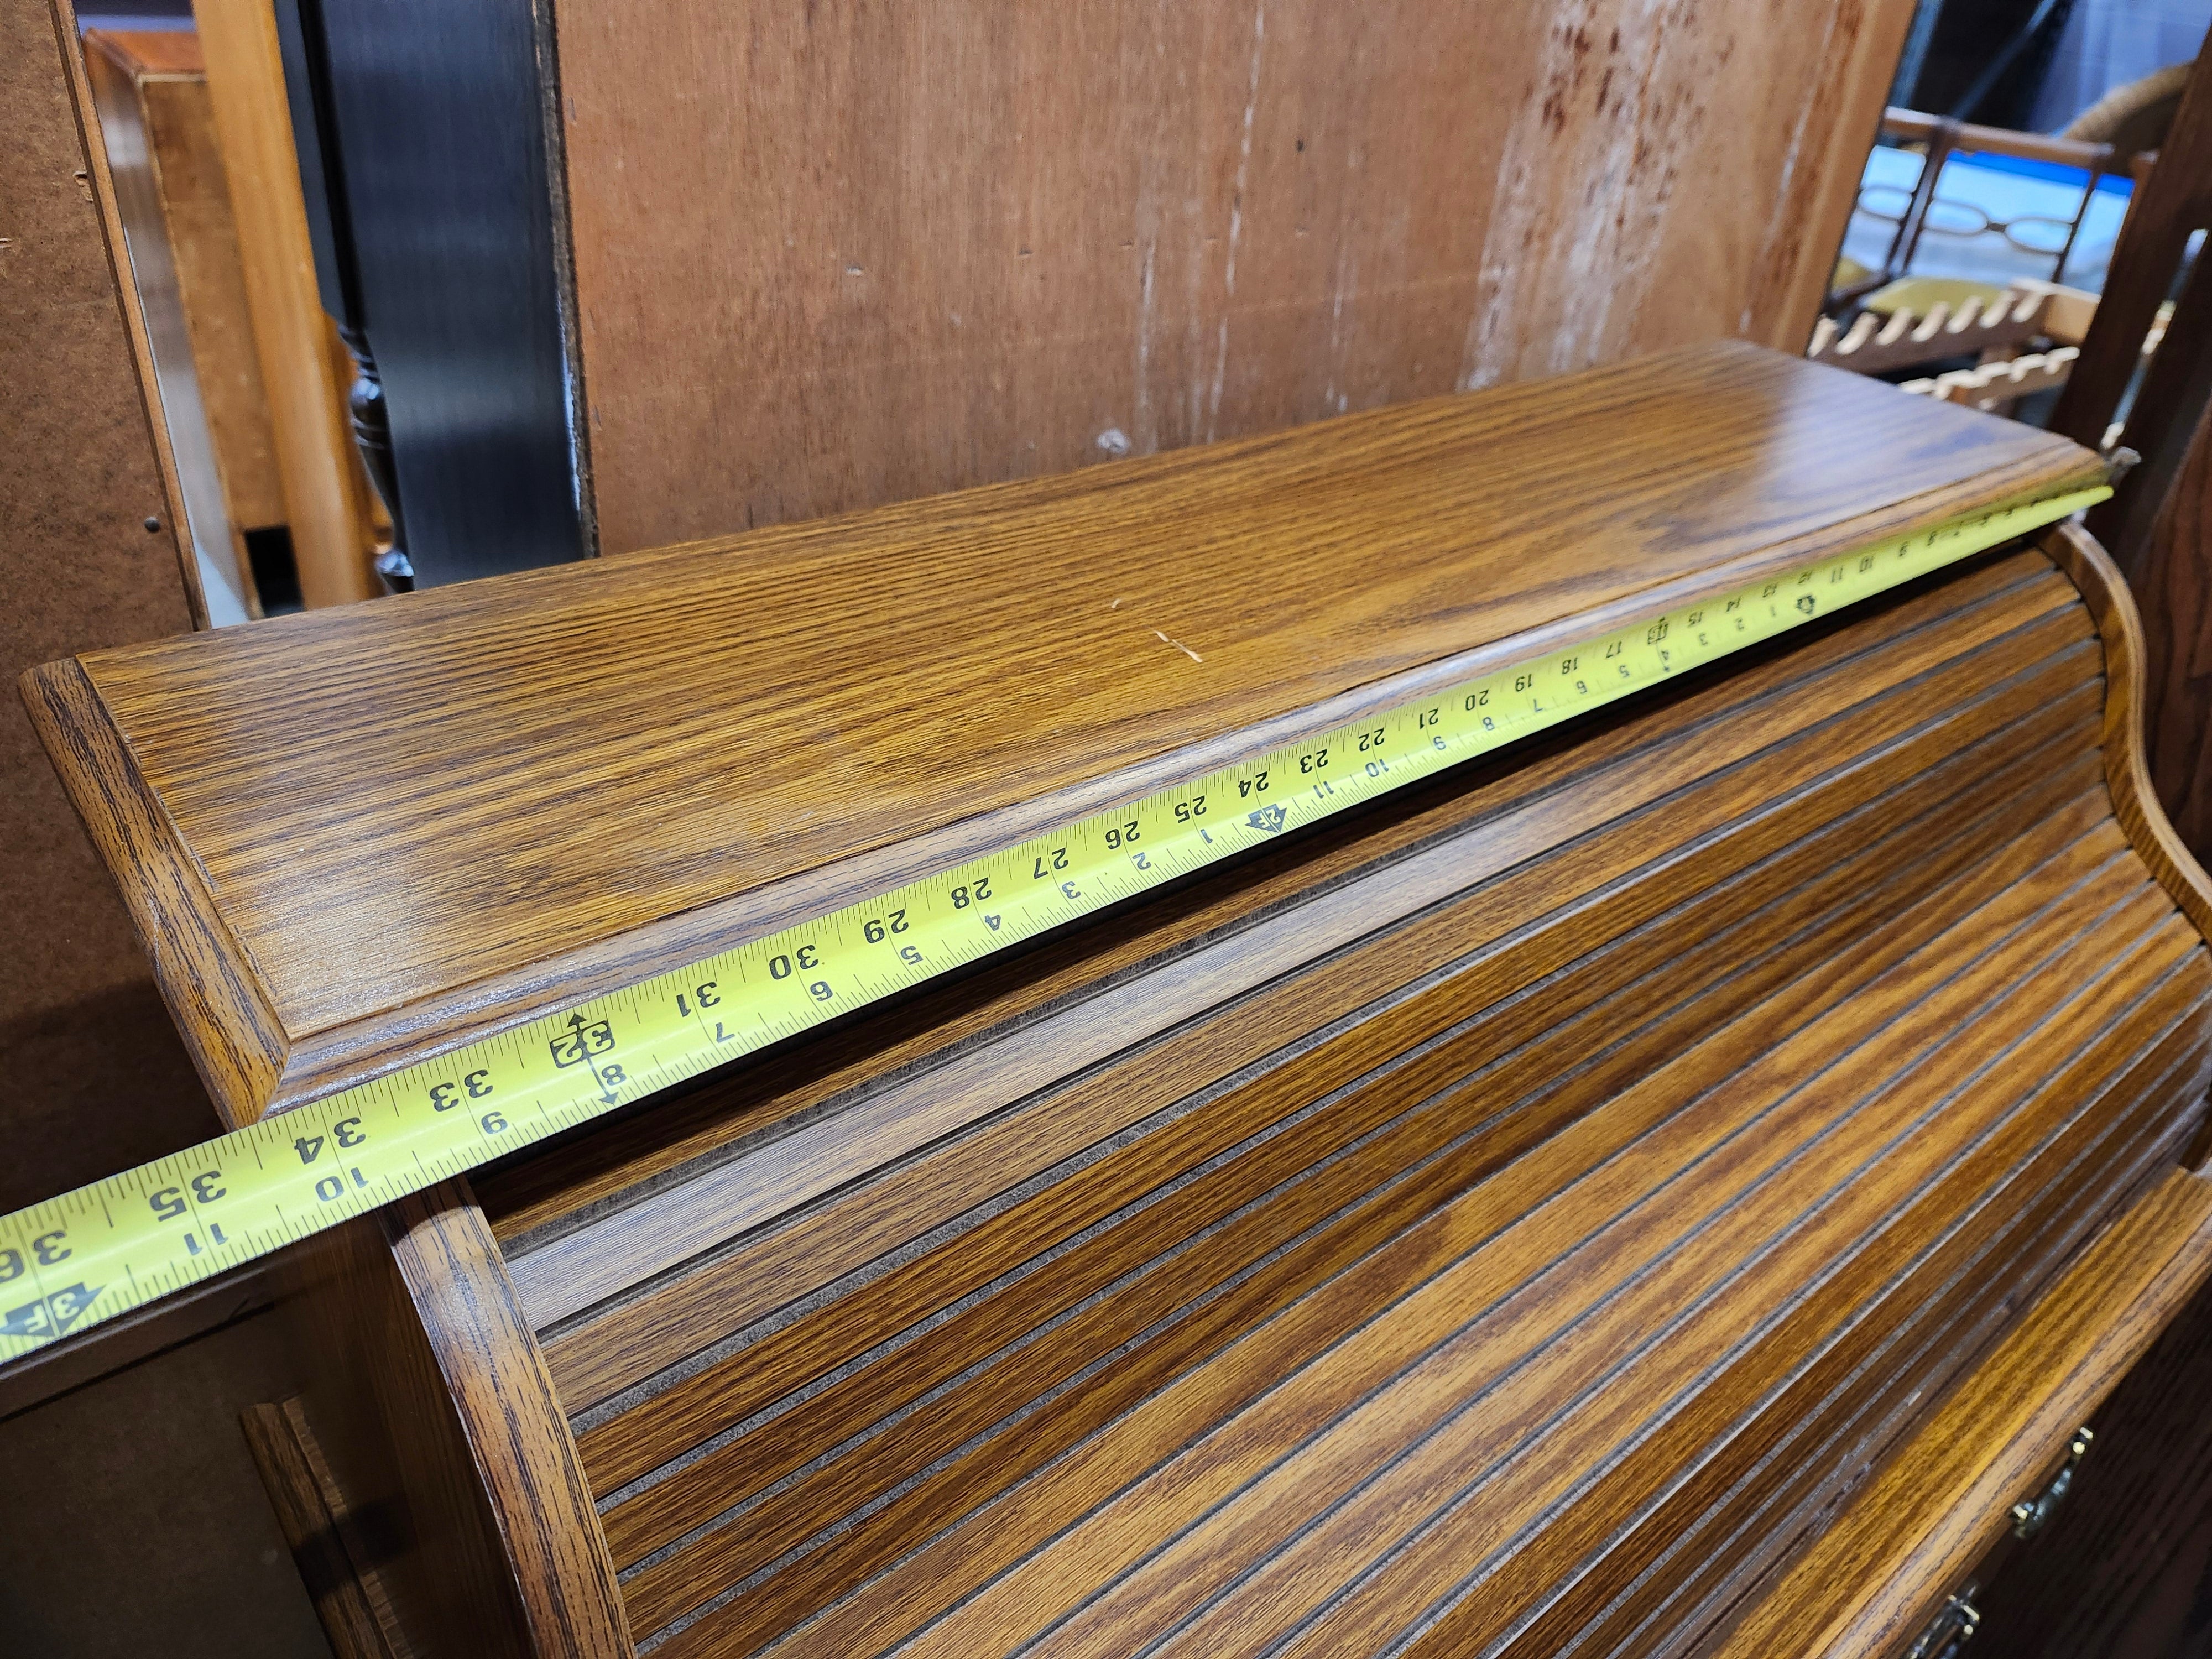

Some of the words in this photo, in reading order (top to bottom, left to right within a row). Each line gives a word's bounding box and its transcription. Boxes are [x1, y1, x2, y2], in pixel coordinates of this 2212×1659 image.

[1859, 555, 1874, 572] 10
[1831, 566, 1843, 583] 11
[1726, 596, 1742, 612] 14
[1688, 611, 1704, 627] 15
[1699, 632, 1708, 645] 3
[1606, 641, 1622, 659] 17
[1562, 658, 1578, 675] 18
[1619, 665, 1630, 677] 5
[1515, 674, 1532, 692] 19
[1577, 681, 1588, 694] 6
[1465, 690, 1489, 711] 20
[1533, 699, 1543, 712] 7
[1420, 708, 1438, 729] 21
[1483, 717, 1495, 731] 8
[1359, 728, 1385, 751] 22
[1433, 736, 1446, 750] 9
[1300, 749, 1328, 774] 23
[1365, 759, 1390, 777] 10
[1238, 771, 1269, 797] 24
[1313, 781, 1334, 799] 11
[1175, 796, 1207, 823] 25
[1257, 807, 1281, 830] 2F
[1105, 821, 1140, 849] 26
[1201, 829, 1213, 843] 1
[1034, 848, 1068, 879] 27
[1132, 852, 1151, 870] 2
[951, 877, 992, 909] 28
[1062, 881, 1081, 899] 3
[864, 909, 909, 943] 29
[984, 915, 1001, 931] 4
[769, 945, 818, 980] 30
[900, 946, 924, 965] 5
[676, 982, 721, 1016] 31
[810, 981, 833, 1001] 6
[716, 1022, 735, 1042] 7
[551, 1022, 613, 1067] 32
[601, 1064, 627, 1086] 8
[429, 1069, 493, 1112] 33
[481, 1112, 508, 1134] 9
[294, 1117, 366, 1164] 34
[315, 1167, 369, 1201] 10
[149, 1171, 227, 1222] 35
[184, 1223, 228, 1256] 11
[0, 1230, 72, 1284] 36
[24, 1292, 80, 1333] 3F
